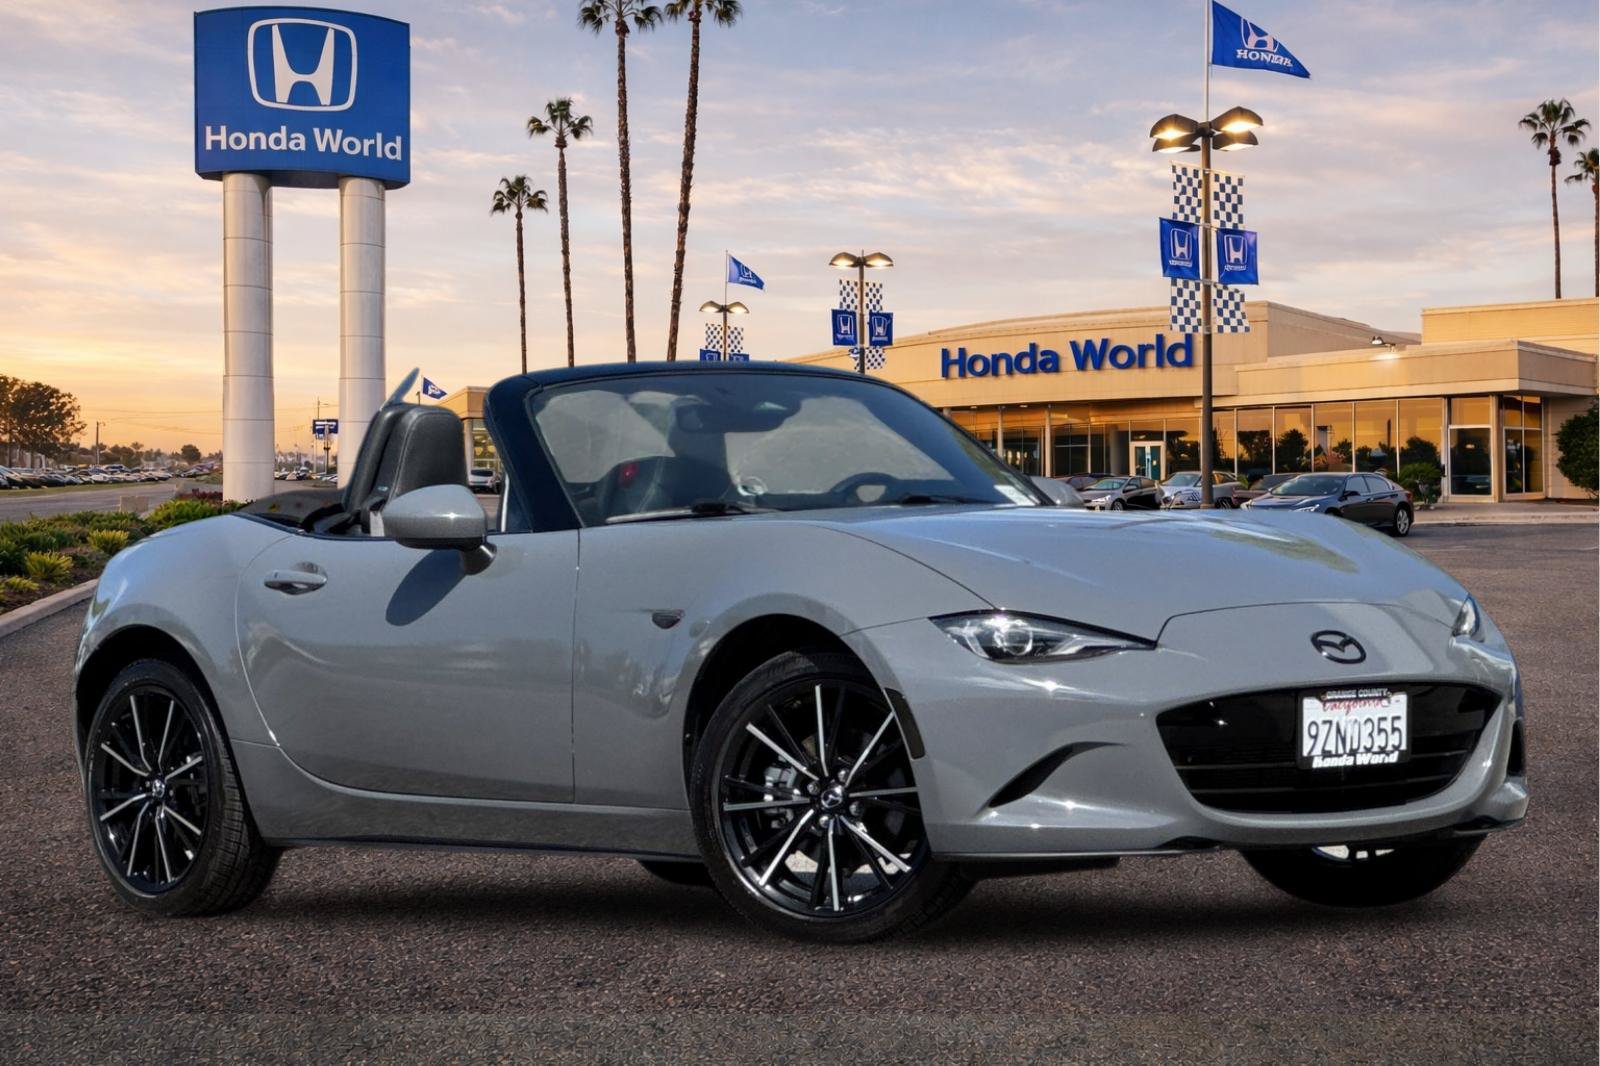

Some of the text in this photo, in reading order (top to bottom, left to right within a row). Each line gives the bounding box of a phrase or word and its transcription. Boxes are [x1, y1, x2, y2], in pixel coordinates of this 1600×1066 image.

[205, 125, 402, 160] Honda World
[941, 333, 1194, 379] Honda World
[1358, 688, 1388, 698] COUNTY
